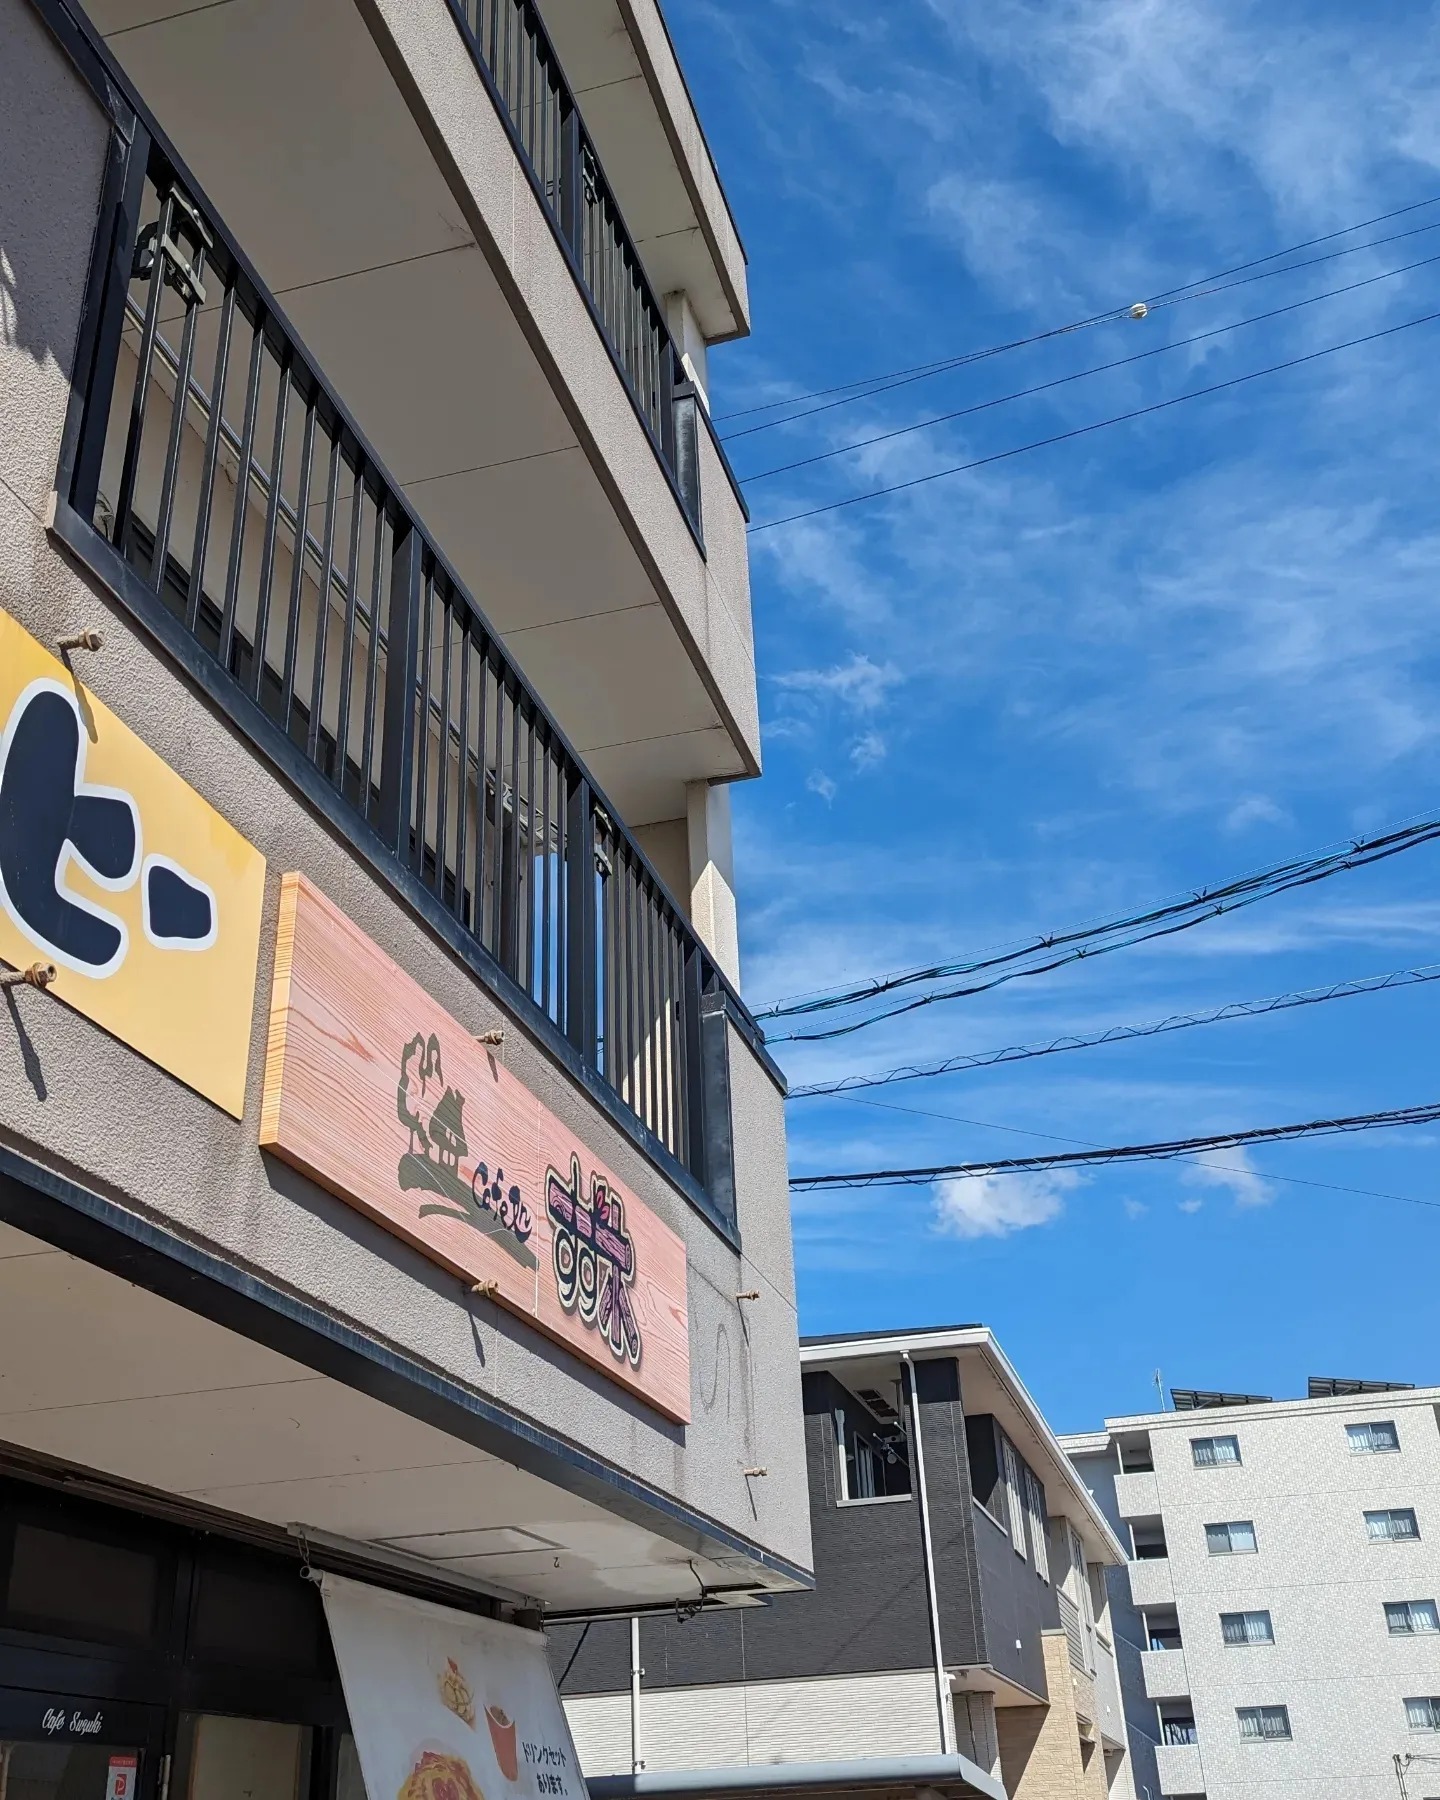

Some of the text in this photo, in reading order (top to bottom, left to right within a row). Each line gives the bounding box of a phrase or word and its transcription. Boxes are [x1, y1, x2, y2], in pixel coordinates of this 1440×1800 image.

[42, 1707, 104, 1736] Cafe Suzuki
[521, 1741, 567, 1768] ドリンクセット
